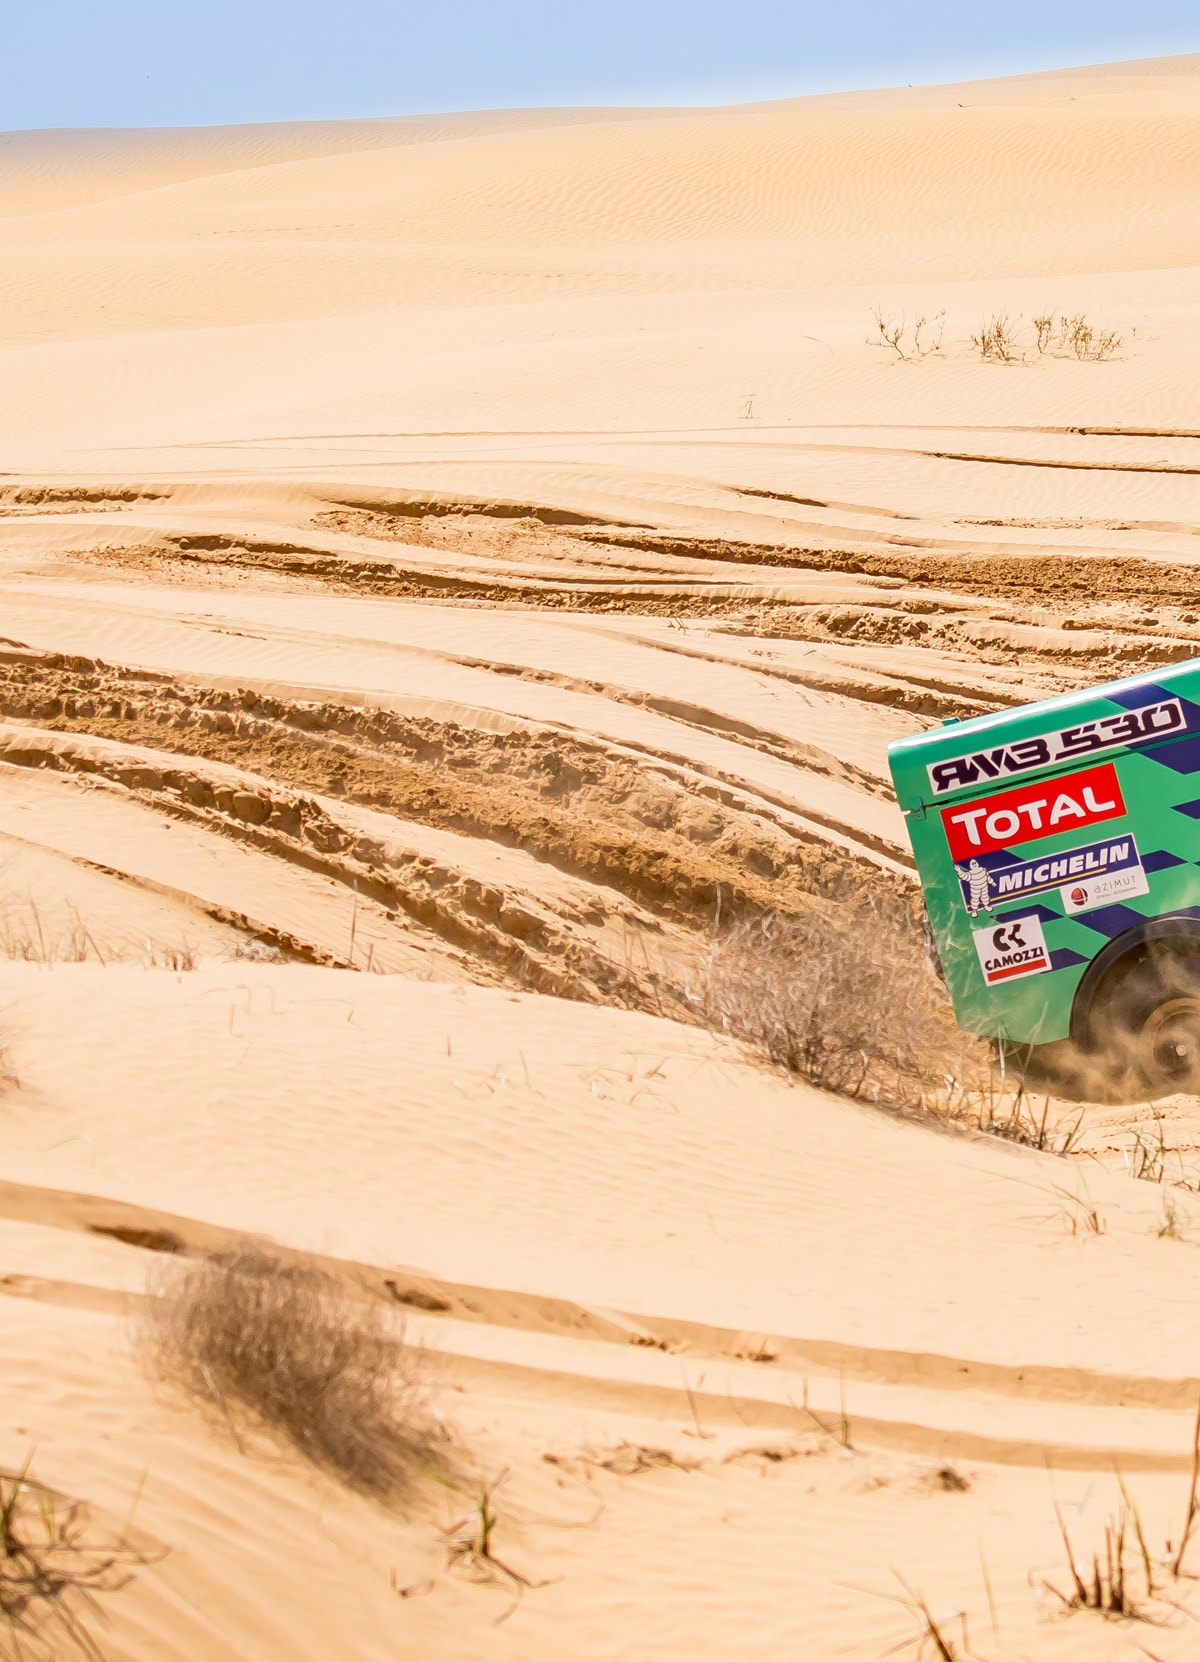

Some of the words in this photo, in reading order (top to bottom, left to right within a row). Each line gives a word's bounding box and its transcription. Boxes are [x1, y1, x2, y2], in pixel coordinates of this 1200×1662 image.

[1054, 702, 1183, 758] 530
[951, 786, 1116, 847] TOTAL
[998, 842, 1130, 894] MICHELIN
[984, 946, 1044, 972] CAMOZZI
